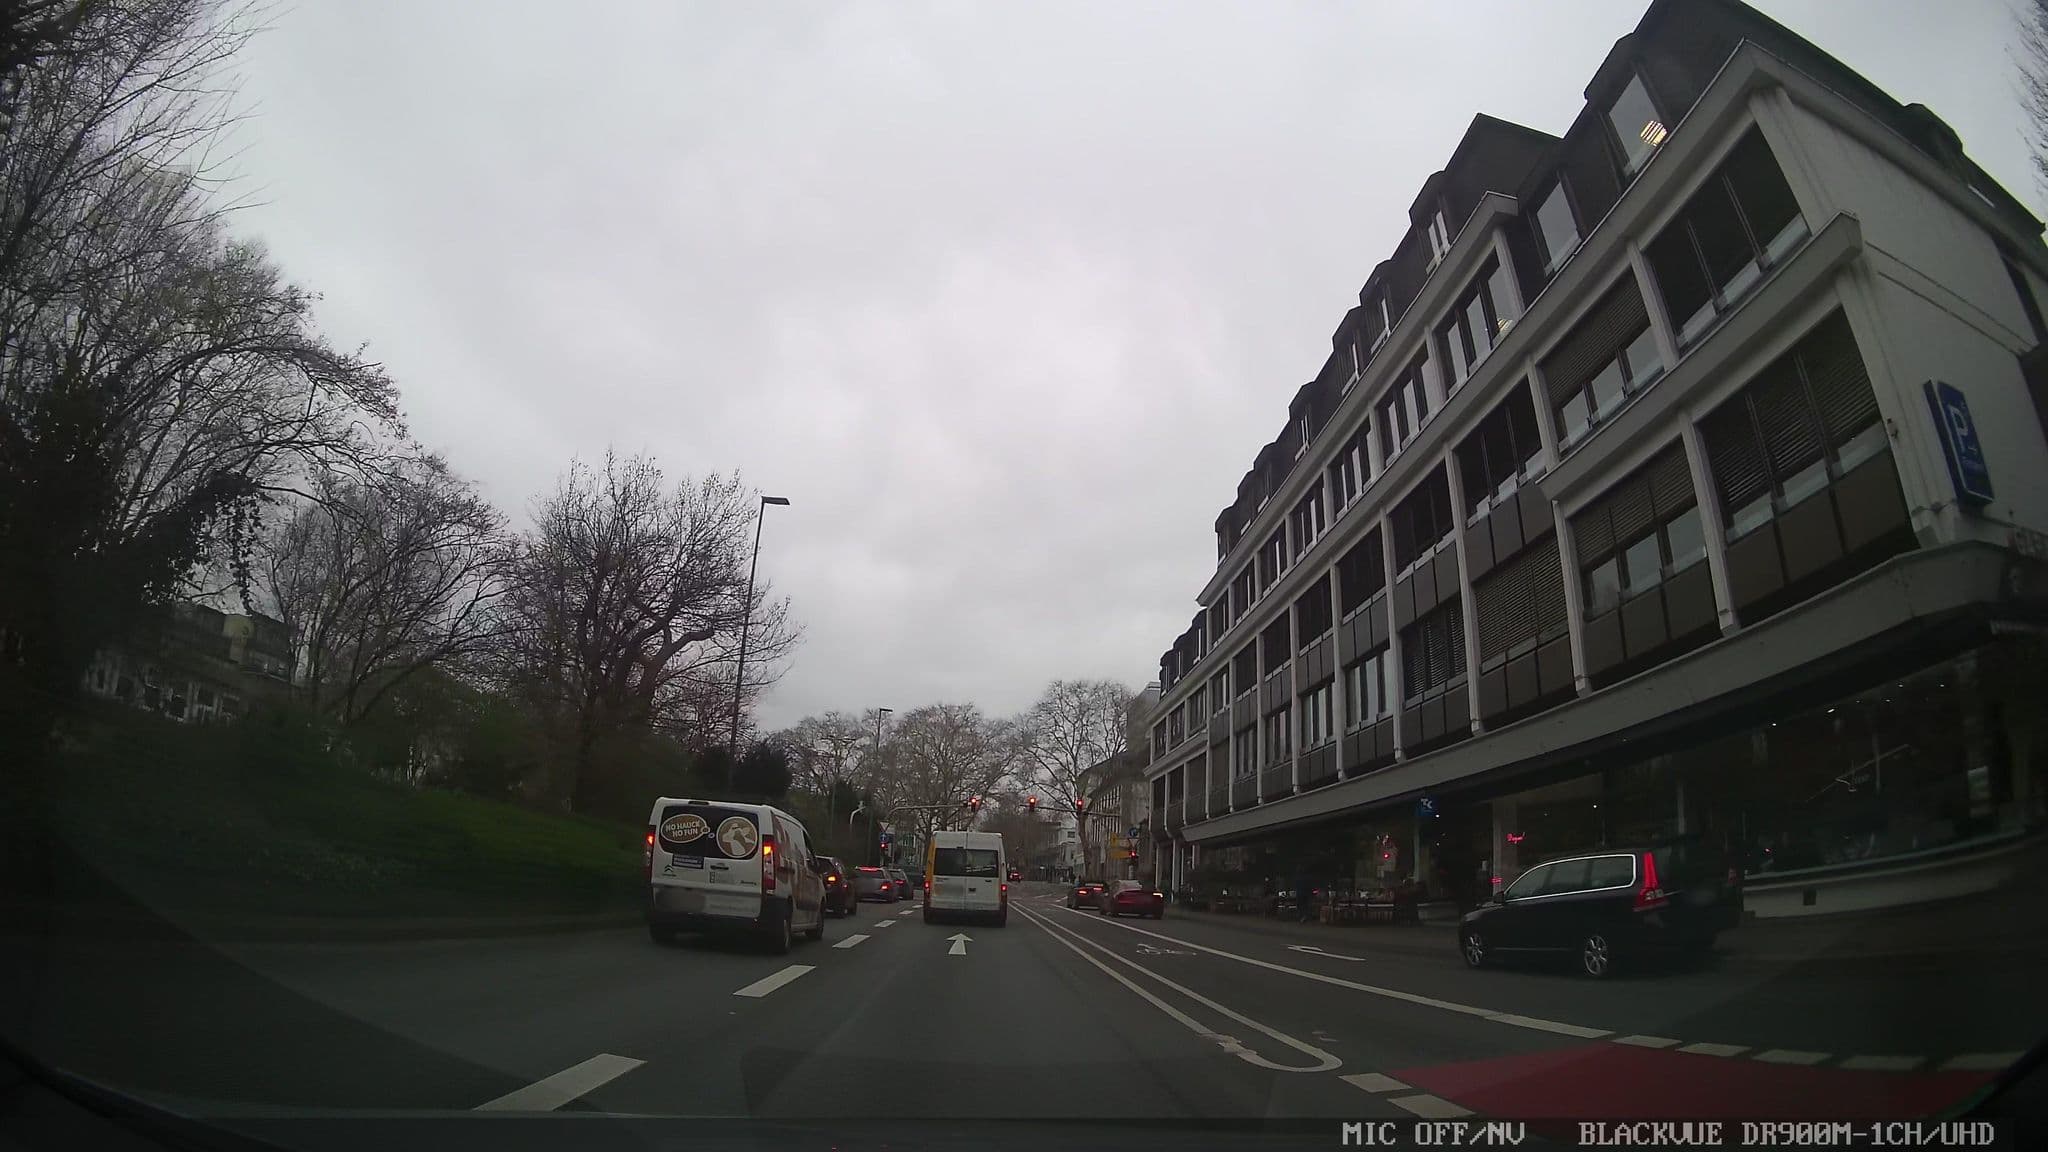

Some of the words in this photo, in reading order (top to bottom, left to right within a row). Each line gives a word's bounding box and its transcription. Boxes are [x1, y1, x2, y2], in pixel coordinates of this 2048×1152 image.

[1948, 404, 1968, 452] P
[665, 824, 677, 833] NO
[672, 830, 683, 838] NO
[684, 827, 698, 836] FUN
